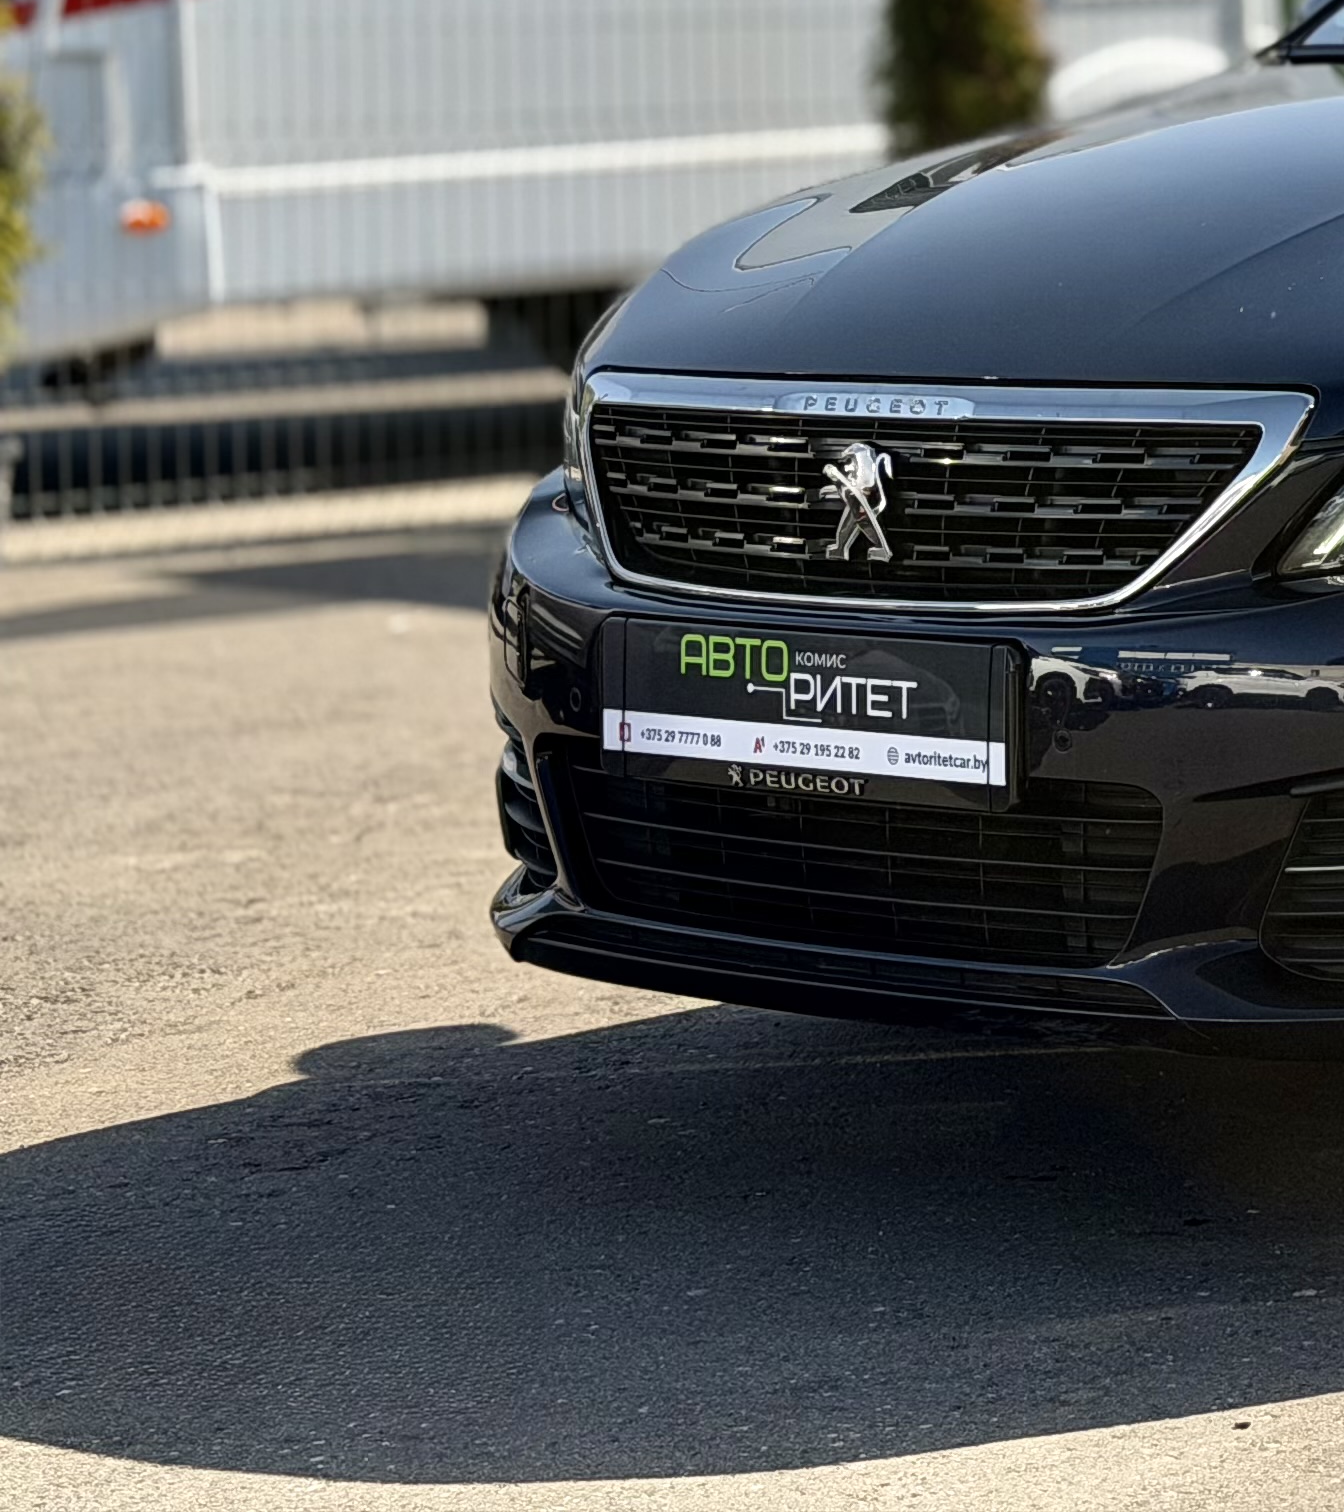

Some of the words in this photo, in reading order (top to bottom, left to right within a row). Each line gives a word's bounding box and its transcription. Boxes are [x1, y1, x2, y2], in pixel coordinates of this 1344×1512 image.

[803, 395, 949, 416] PEUGEOT
[680, 633, 789, 682] АВТО
[795, 651, 847, 669] КОМИС
[790, 672, 918, 719] РИТЕТ
[640, 728, 662, 743] +375
[664, 729, 676, 743] 29
[677, 730, 701, 746] 7777
[702, 733, 709, 747] 0
[710, 734, 722, 748] 88
[772, 740, 798, 755] +375
[800, 742, 812, 756] 29
[814, 743, 832, 758] 195
[834, 745, 847, 759] 22
[848, 746, 861, 761] 82
[904, 750, 988, 774] avtoritetcar.by
[750, 768, 865, 796] PEUGEOT
